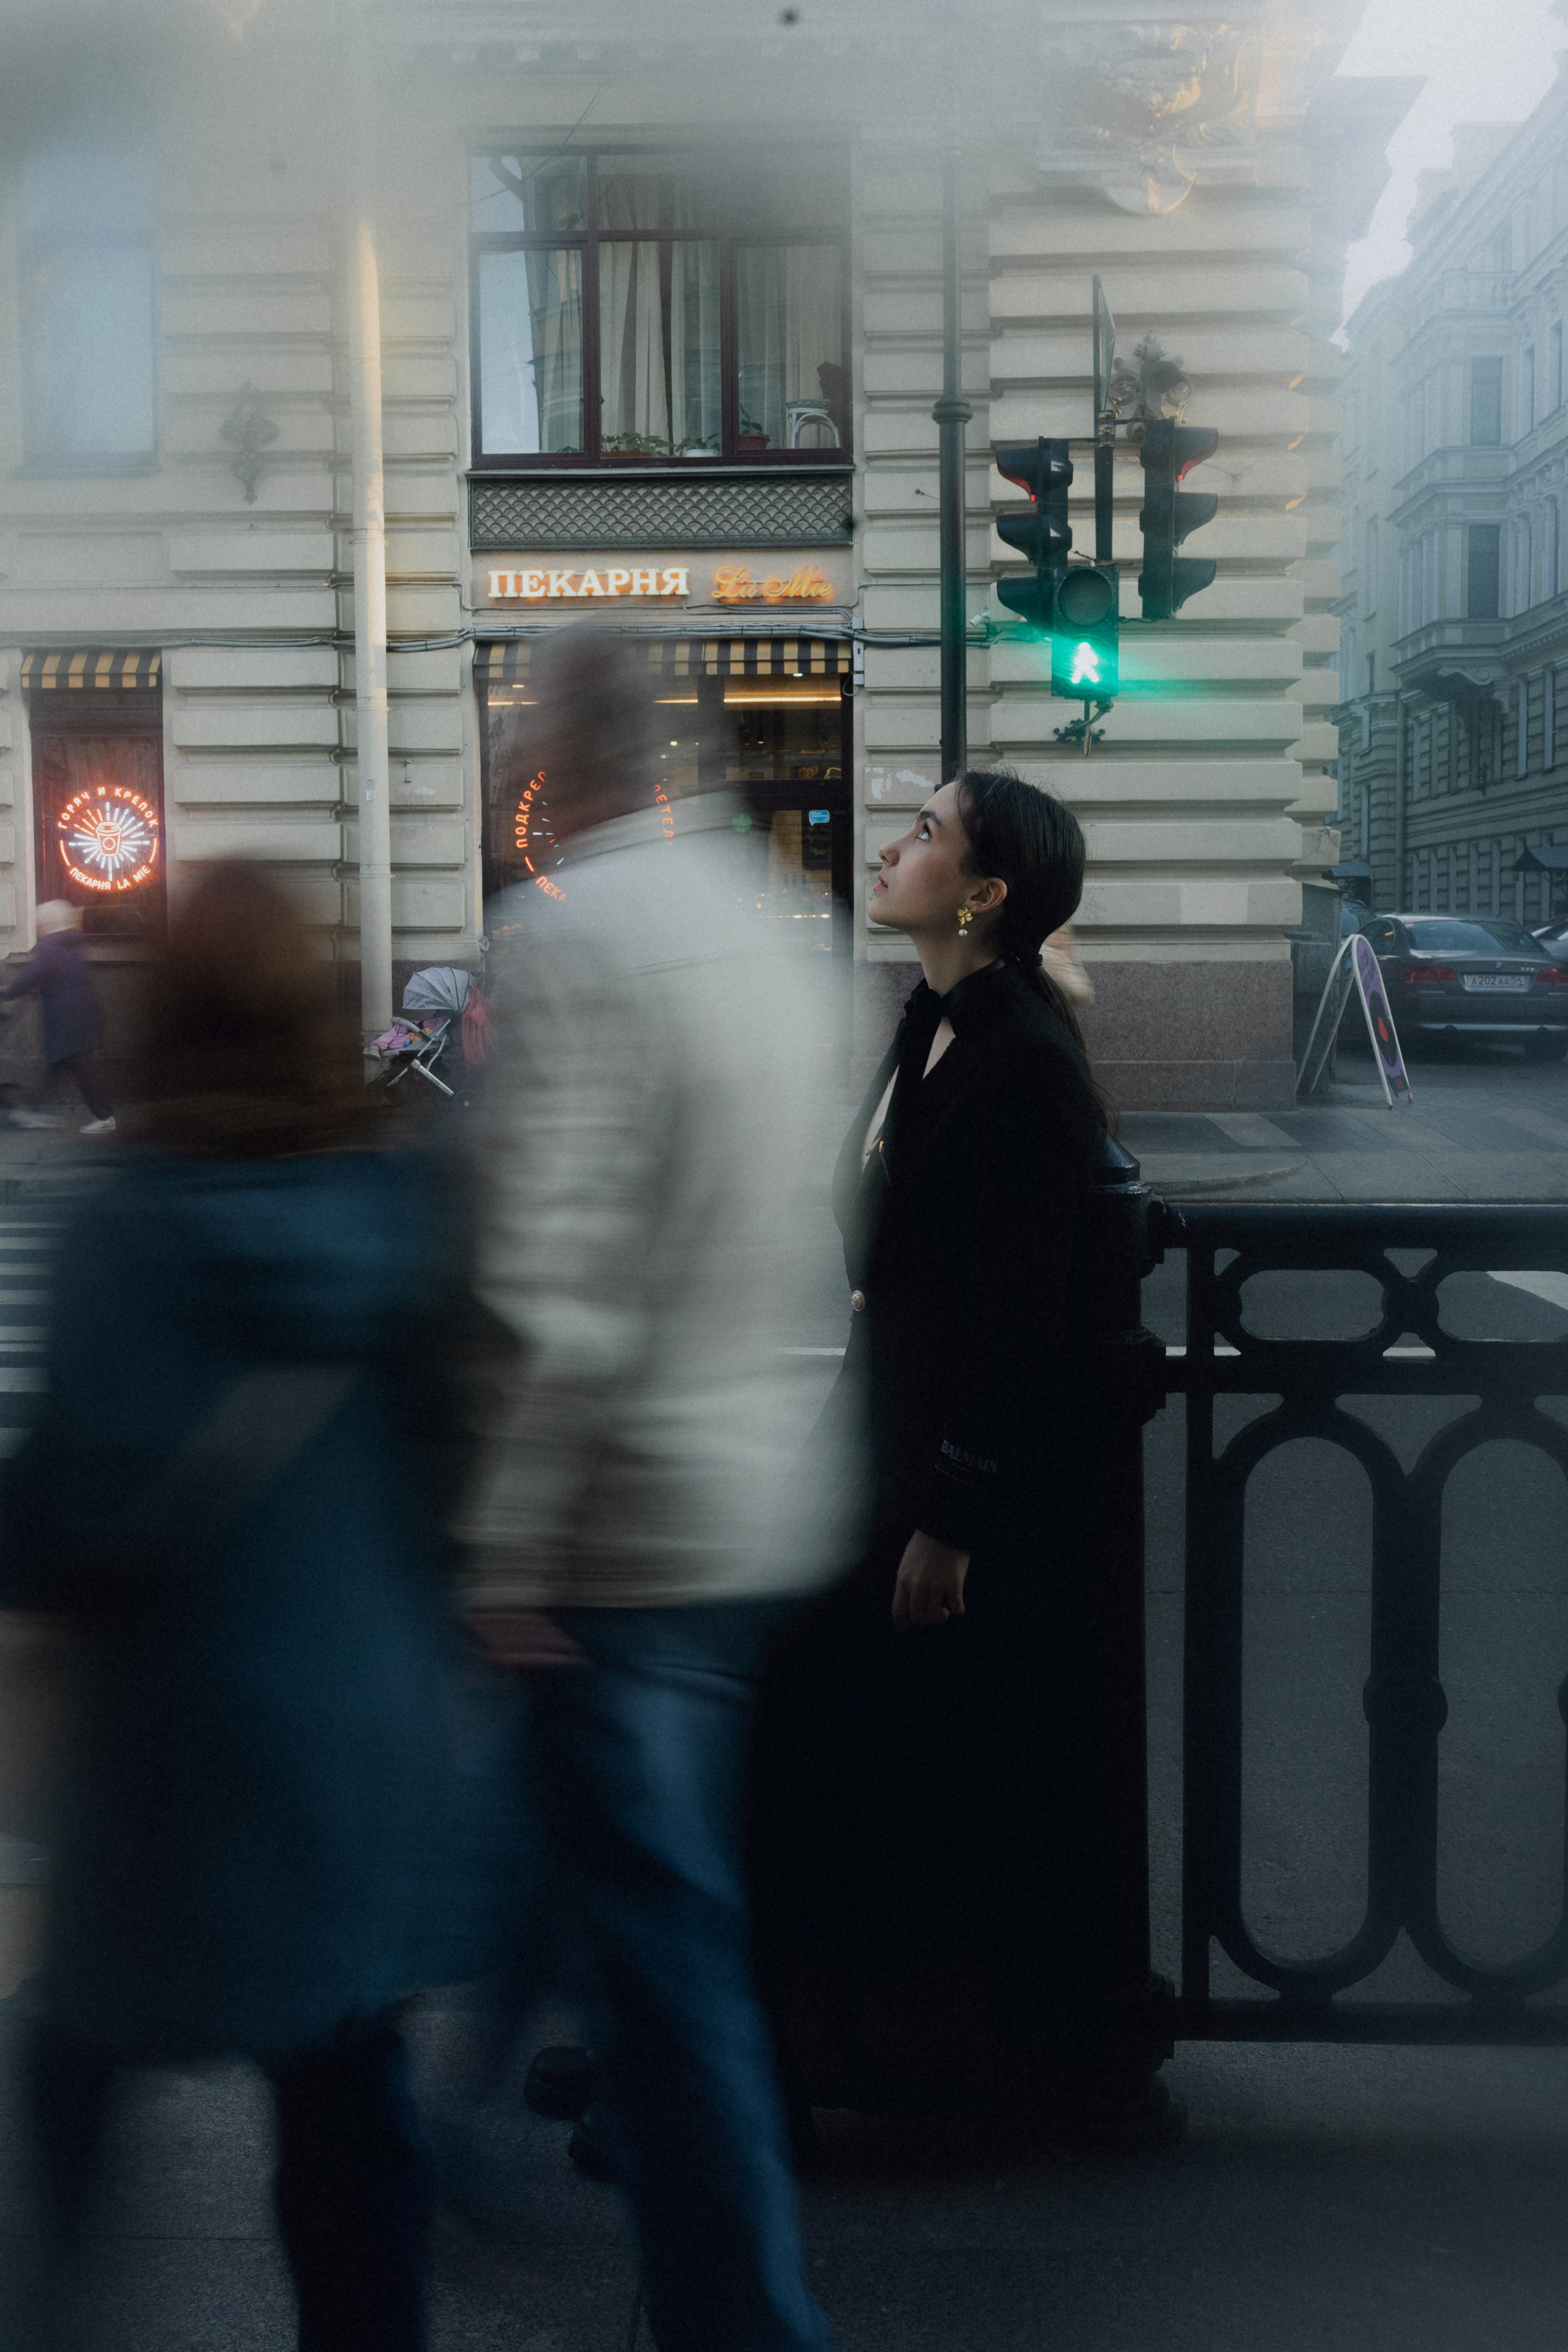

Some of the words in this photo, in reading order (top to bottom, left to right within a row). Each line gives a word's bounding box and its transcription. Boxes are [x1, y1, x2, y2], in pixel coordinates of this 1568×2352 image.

[488, 568, 690, 598] ПЕКАРНЯ
[711, 565, 758, 598] La
[764, 565, 833, 598] Mie
[58, 791, 90, 829] ГОРЯЧ
[98, 787, 105, 796] И
[115, 788, 158, 828] КРЕПОК
[515, 771, 546, 848] ПОДКРЕП
[69, 867, 111, 890] ПЕКАРНЯ
[117, 878, 130, 889] LA
[133, 865, 151, 882] MIE
[535, 875, 567, 901] ПЕКА
